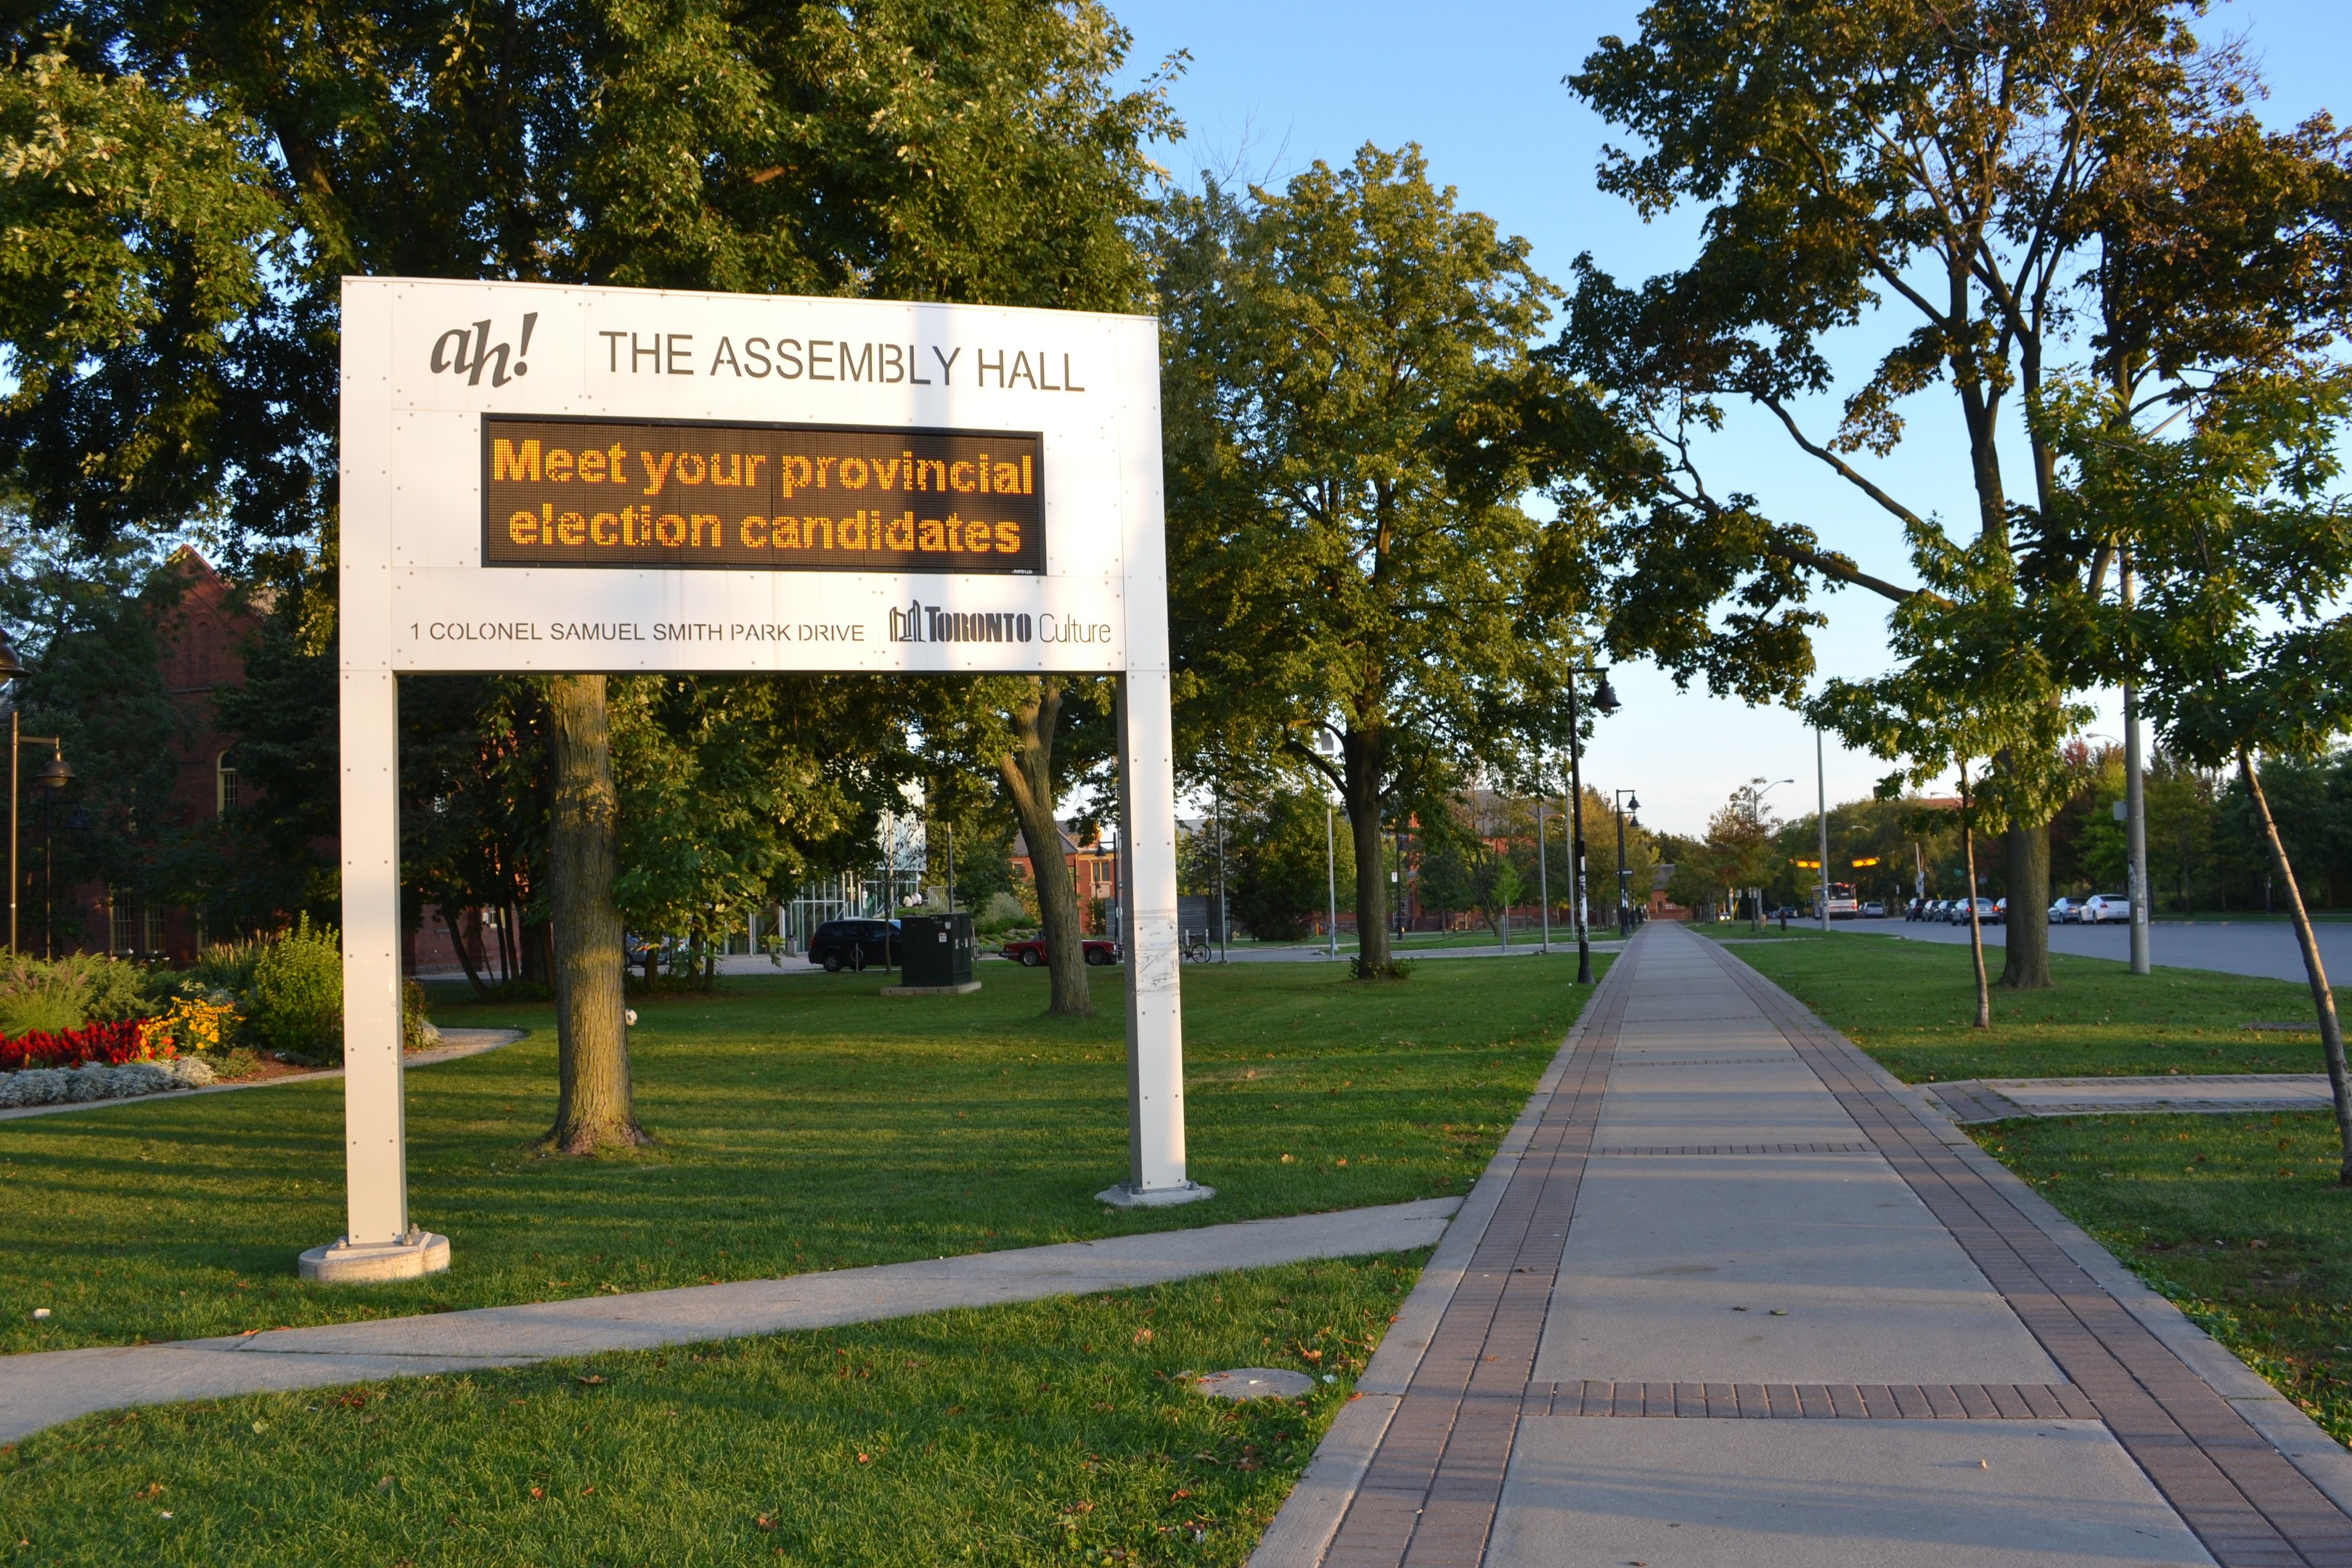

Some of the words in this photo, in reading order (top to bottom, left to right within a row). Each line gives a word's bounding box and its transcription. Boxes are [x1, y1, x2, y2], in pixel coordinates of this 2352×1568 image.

[430, 312, 538, 388] ah!
[600, 331, 694, 375] THE
[710, 336, 961, 386] ASSEMBLY
[978, 348, 1085, 392] HALL
[494, 438, 627, 483] Meet
[640, 451, 767, 497] your
[783, 451, 1032, 499] provincial
[510, 503, 722, 548] election
[740, 510, 1021, 553] candidates
[411, 622, 418, 640] 1
[430, 622, 543, 640] COLONEL
[550, 623, 646, 640] SAMUEL
[653, 623, 722, 641] SMITH
[731, 624, 791, 641] PARK
[799, 624, 865, 642] DRIVE
[1039, 613, 1111, 643] Culture
